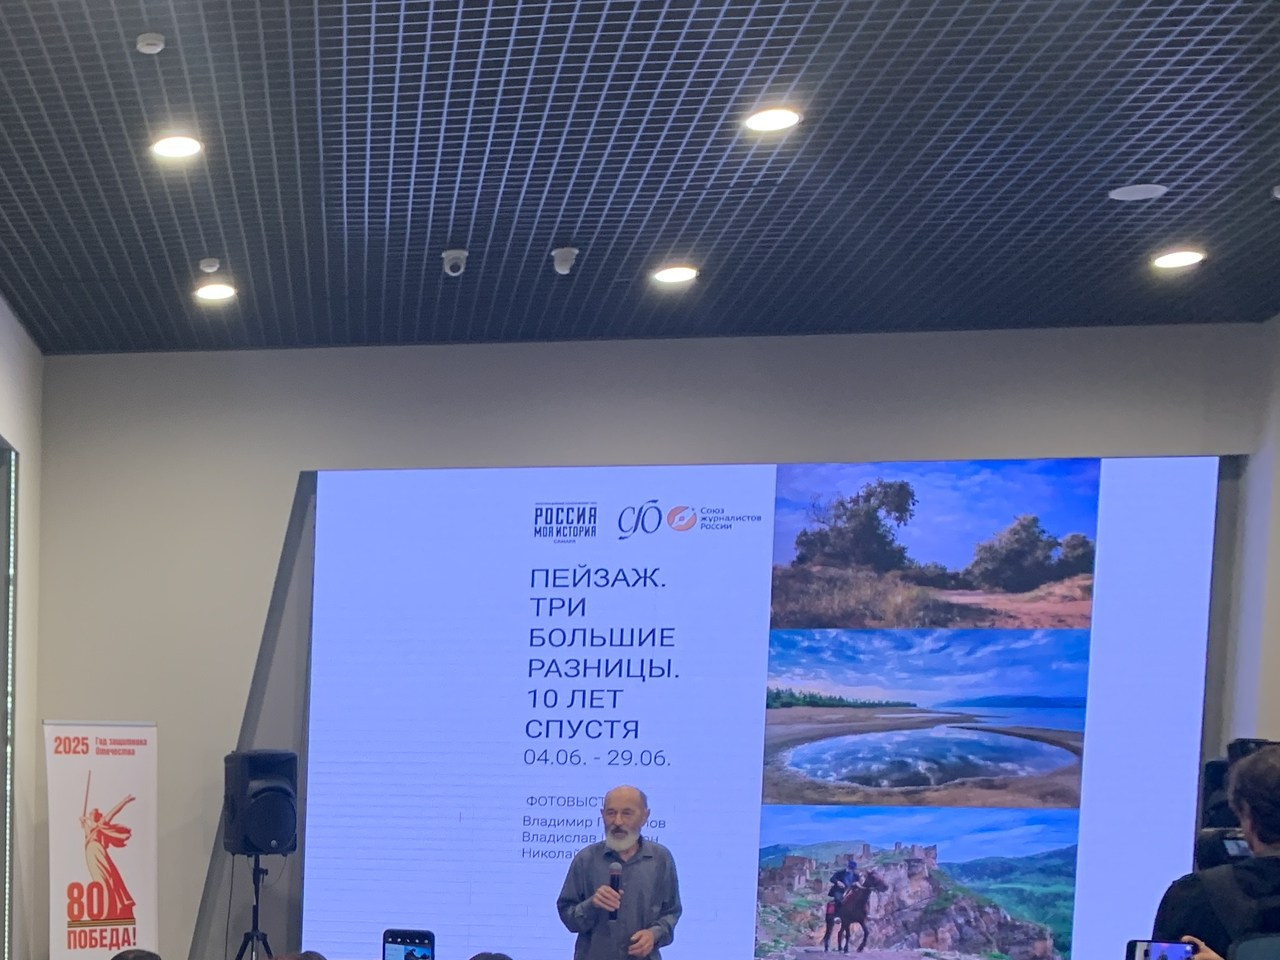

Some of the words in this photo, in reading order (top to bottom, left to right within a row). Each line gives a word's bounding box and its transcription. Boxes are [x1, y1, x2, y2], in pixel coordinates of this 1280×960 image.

[534, 506, 598, 525] РОССИЯ
[700, 515, 762, 523] журналистов
[533, 525, 554, 538] МОЯ
[555, 525, 597, 538] ИСТОРИЯ
[700, 522, 732, 530] России
[530, 563, 667, 588] ПЕЙЗАЖ.
[530, 597, 587, 617] ТРИ
[528, 627, 676, 648] БОЛЬШИЕ
[527, 658, 680, 682] РАЗНИЦЫ.
[527, 688, 559, 709] 10
[566, 688, 625, 709] ЛЕТ
[524, 719, 640, 739] СПУСТЯ
[53, 736, 90, 755] 2025
[523, 748, 587, 765] 04.06.
[607, 749, 671, 766] 29.06.
[522, 815, 593, 829] Владимир
[522, 831, 597, 844] Владислав
[66, 881, 104, 921] 80
[66, 927, 137, 950] ПОБЕДА!
